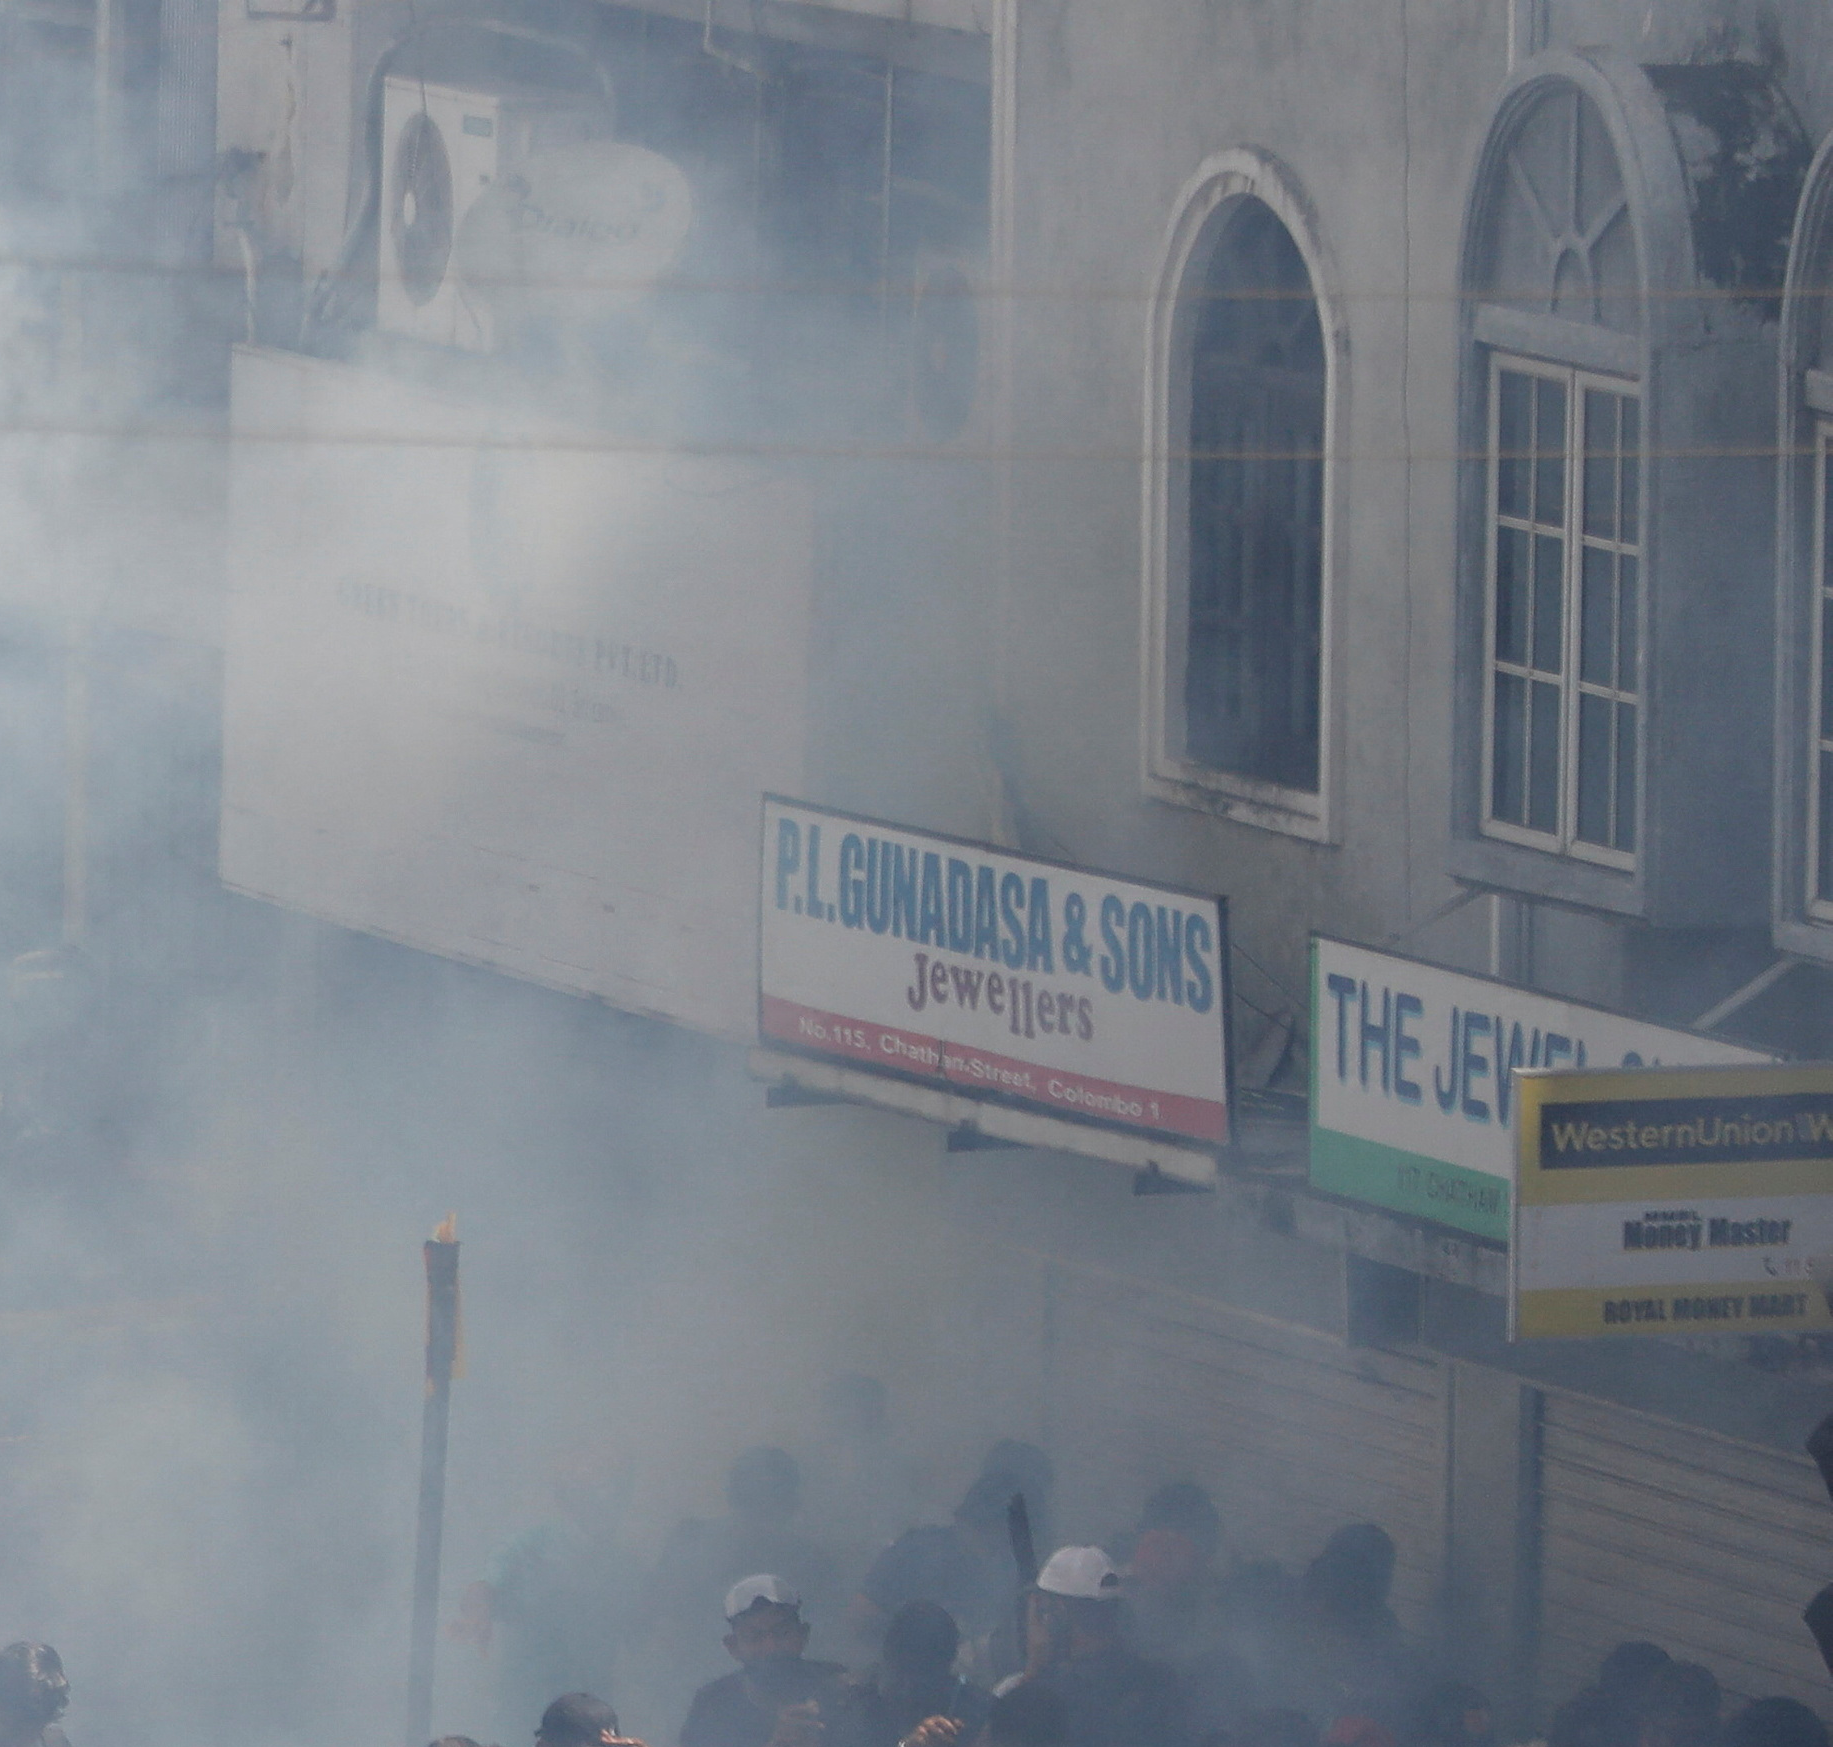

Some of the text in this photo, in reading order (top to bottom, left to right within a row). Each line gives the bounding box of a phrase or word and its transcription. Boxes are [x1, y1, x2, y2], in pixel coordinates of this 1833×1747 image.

[1063, 891, 1093, 977] &
[1100, 893, 1214, 1014] SONS
[907, 951, 1095, 1041] Jewellers
[1326, 972, 1425, 1102] THE
[1048, 1079, 1144, 1118] Colombo
[1623, 1219, 1702, 1251] Money
[1603, 1299, 1667, 1325] ROYAL
[1671, 1296, 1745, 1321] MONEY
